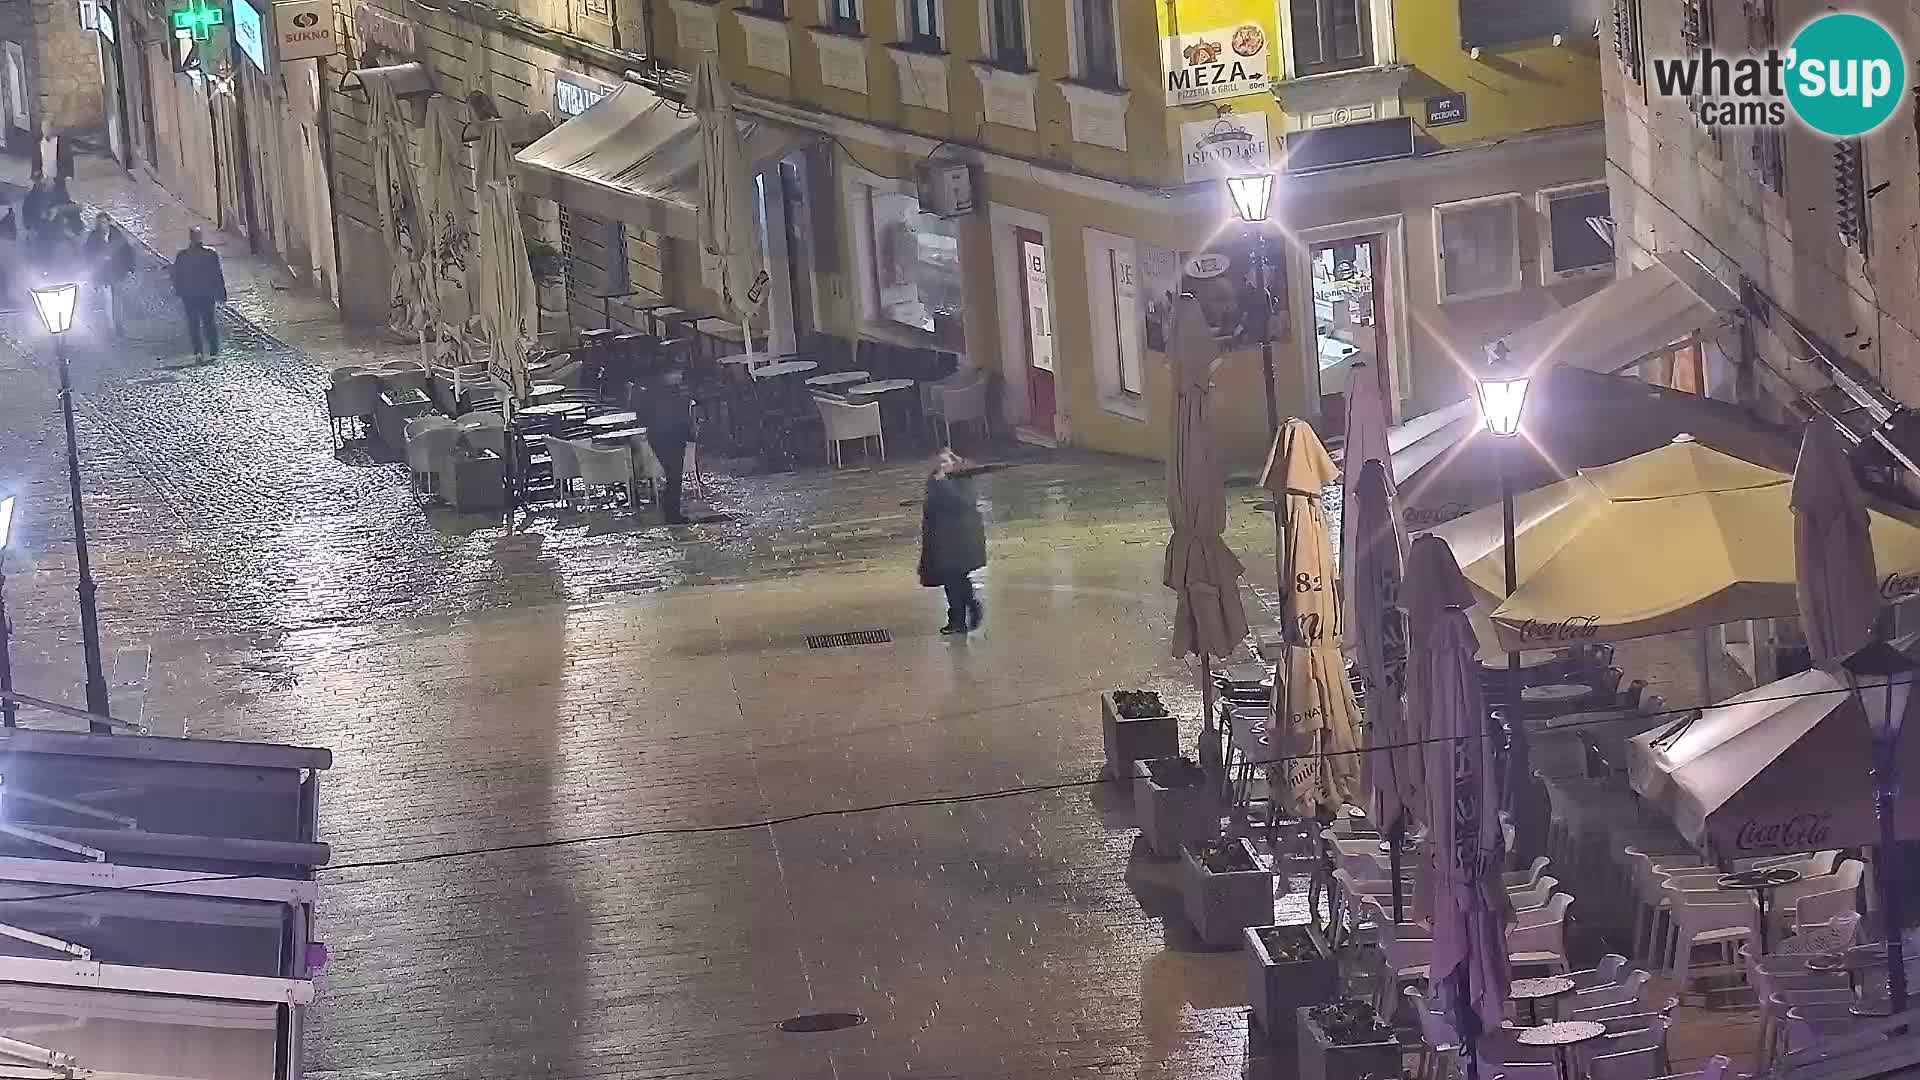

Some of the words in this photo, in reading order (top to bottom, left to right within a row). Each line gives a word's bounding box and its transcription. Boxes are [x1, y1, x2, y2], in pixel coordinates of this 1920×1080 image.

[285, 29, 329, 44] SUKNO
[1168, 61, 1247, 92] MEZA
[1177, 87, 1210, 100] PIZZERIA
[1218, 83, 1239, 94] GRILL
[1248, 82, 1265, 90] 80m
